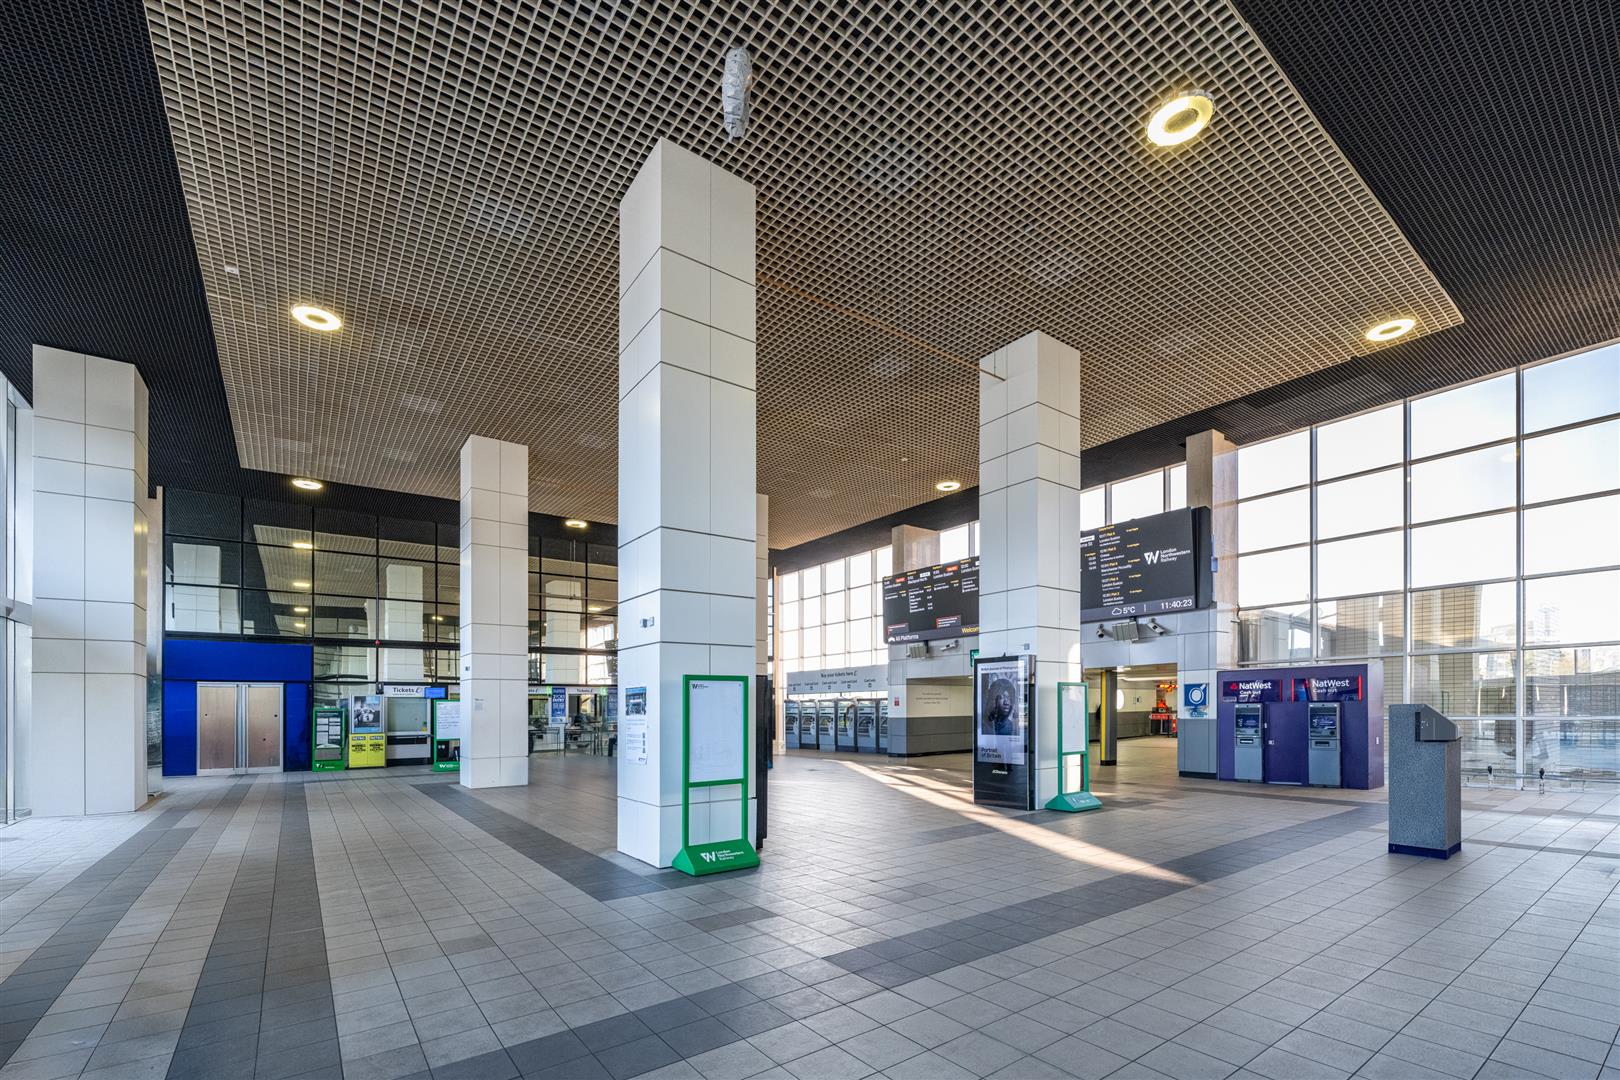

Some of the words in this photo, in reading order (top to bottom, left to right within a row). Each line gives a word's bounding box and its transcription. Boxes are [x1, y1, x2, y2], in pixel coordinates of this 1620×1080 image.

[1161, 550, 1191, 558] Northwestern
[1161, 599, 1192, 610] 11:40:23
[1312, 679, 1350, 688] NatWest
